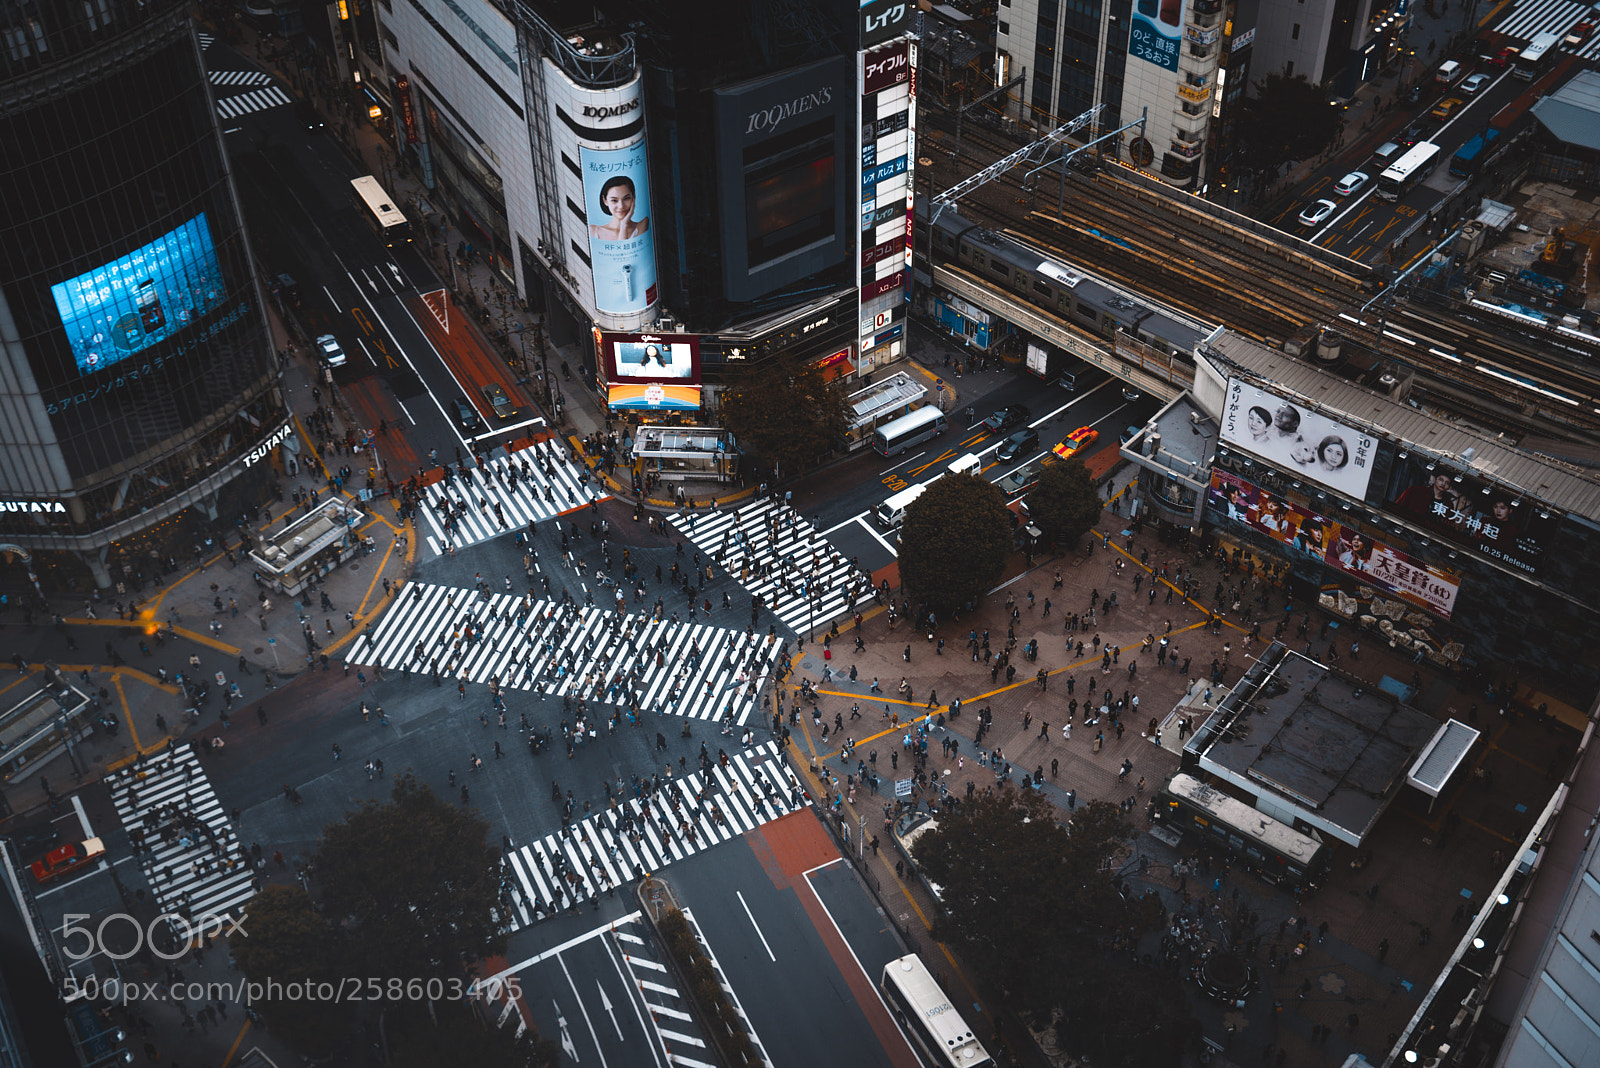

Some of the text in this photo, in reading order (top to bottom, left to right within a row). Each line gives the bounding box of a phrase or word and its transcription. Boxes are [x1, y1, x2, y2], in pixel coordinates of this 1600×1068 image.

[866, 4, 905, 32] レイク
[1133, 29, 1178, 56] のど、直接、
[866, 54, 906, 78] アイフル
[1136, 45, 1170, 66] うるおう
[896, 72, 906, 81] 8F
[876, 207, 894, 221] レイク
[865, 245, 892, 262] アコム
[243, 424, 292, 467] TSUTAYA
[882, 474, 908, 492] 8-20
[1432, 500, 1500, 540] 東方神起
[1479, 543, 1501, 558] 10.25
[1502, 554, 1536, 573] Release
